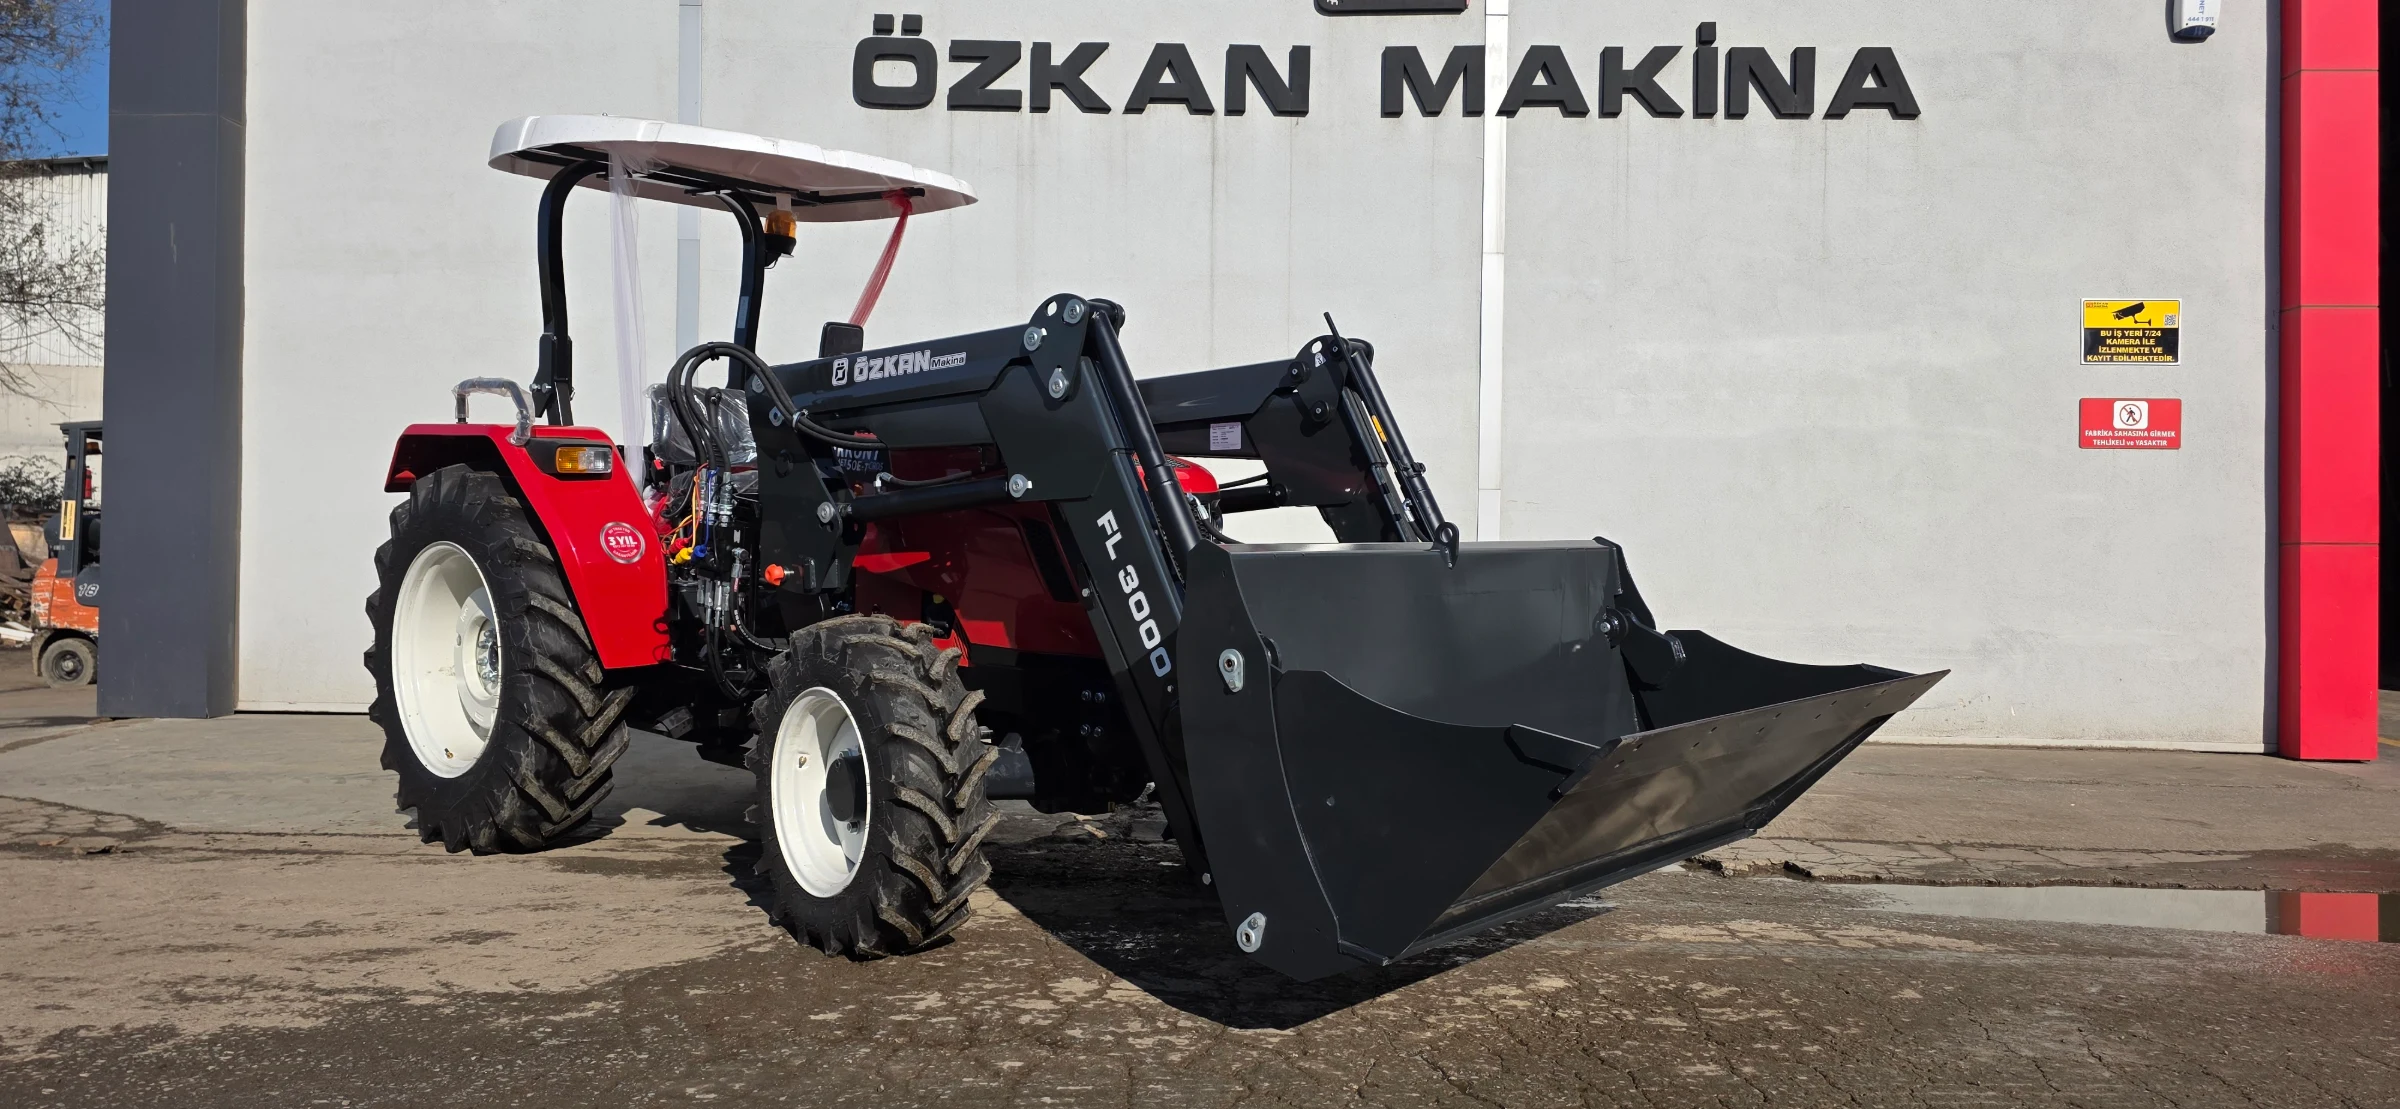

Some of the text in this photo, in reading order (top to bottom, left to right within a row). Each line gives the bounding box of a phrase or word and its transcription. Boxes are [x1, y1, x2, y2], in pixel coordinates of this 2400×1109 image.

[853, 14, 1921, 120] ÖZKAN MAKİNA
[2114, 330, 2122, 338] İŞ
[2113, 354, 2175, 362] EDİLMEKTEDİR.
[853, 350, 930, 382] ÖZKAN
[931, 353, 966, 369] Makina
[608, 536, 638, 546] 3 YIL
[78, 582, 100, 597] 18
[1096, 509, 1172, 678] FL 3000
